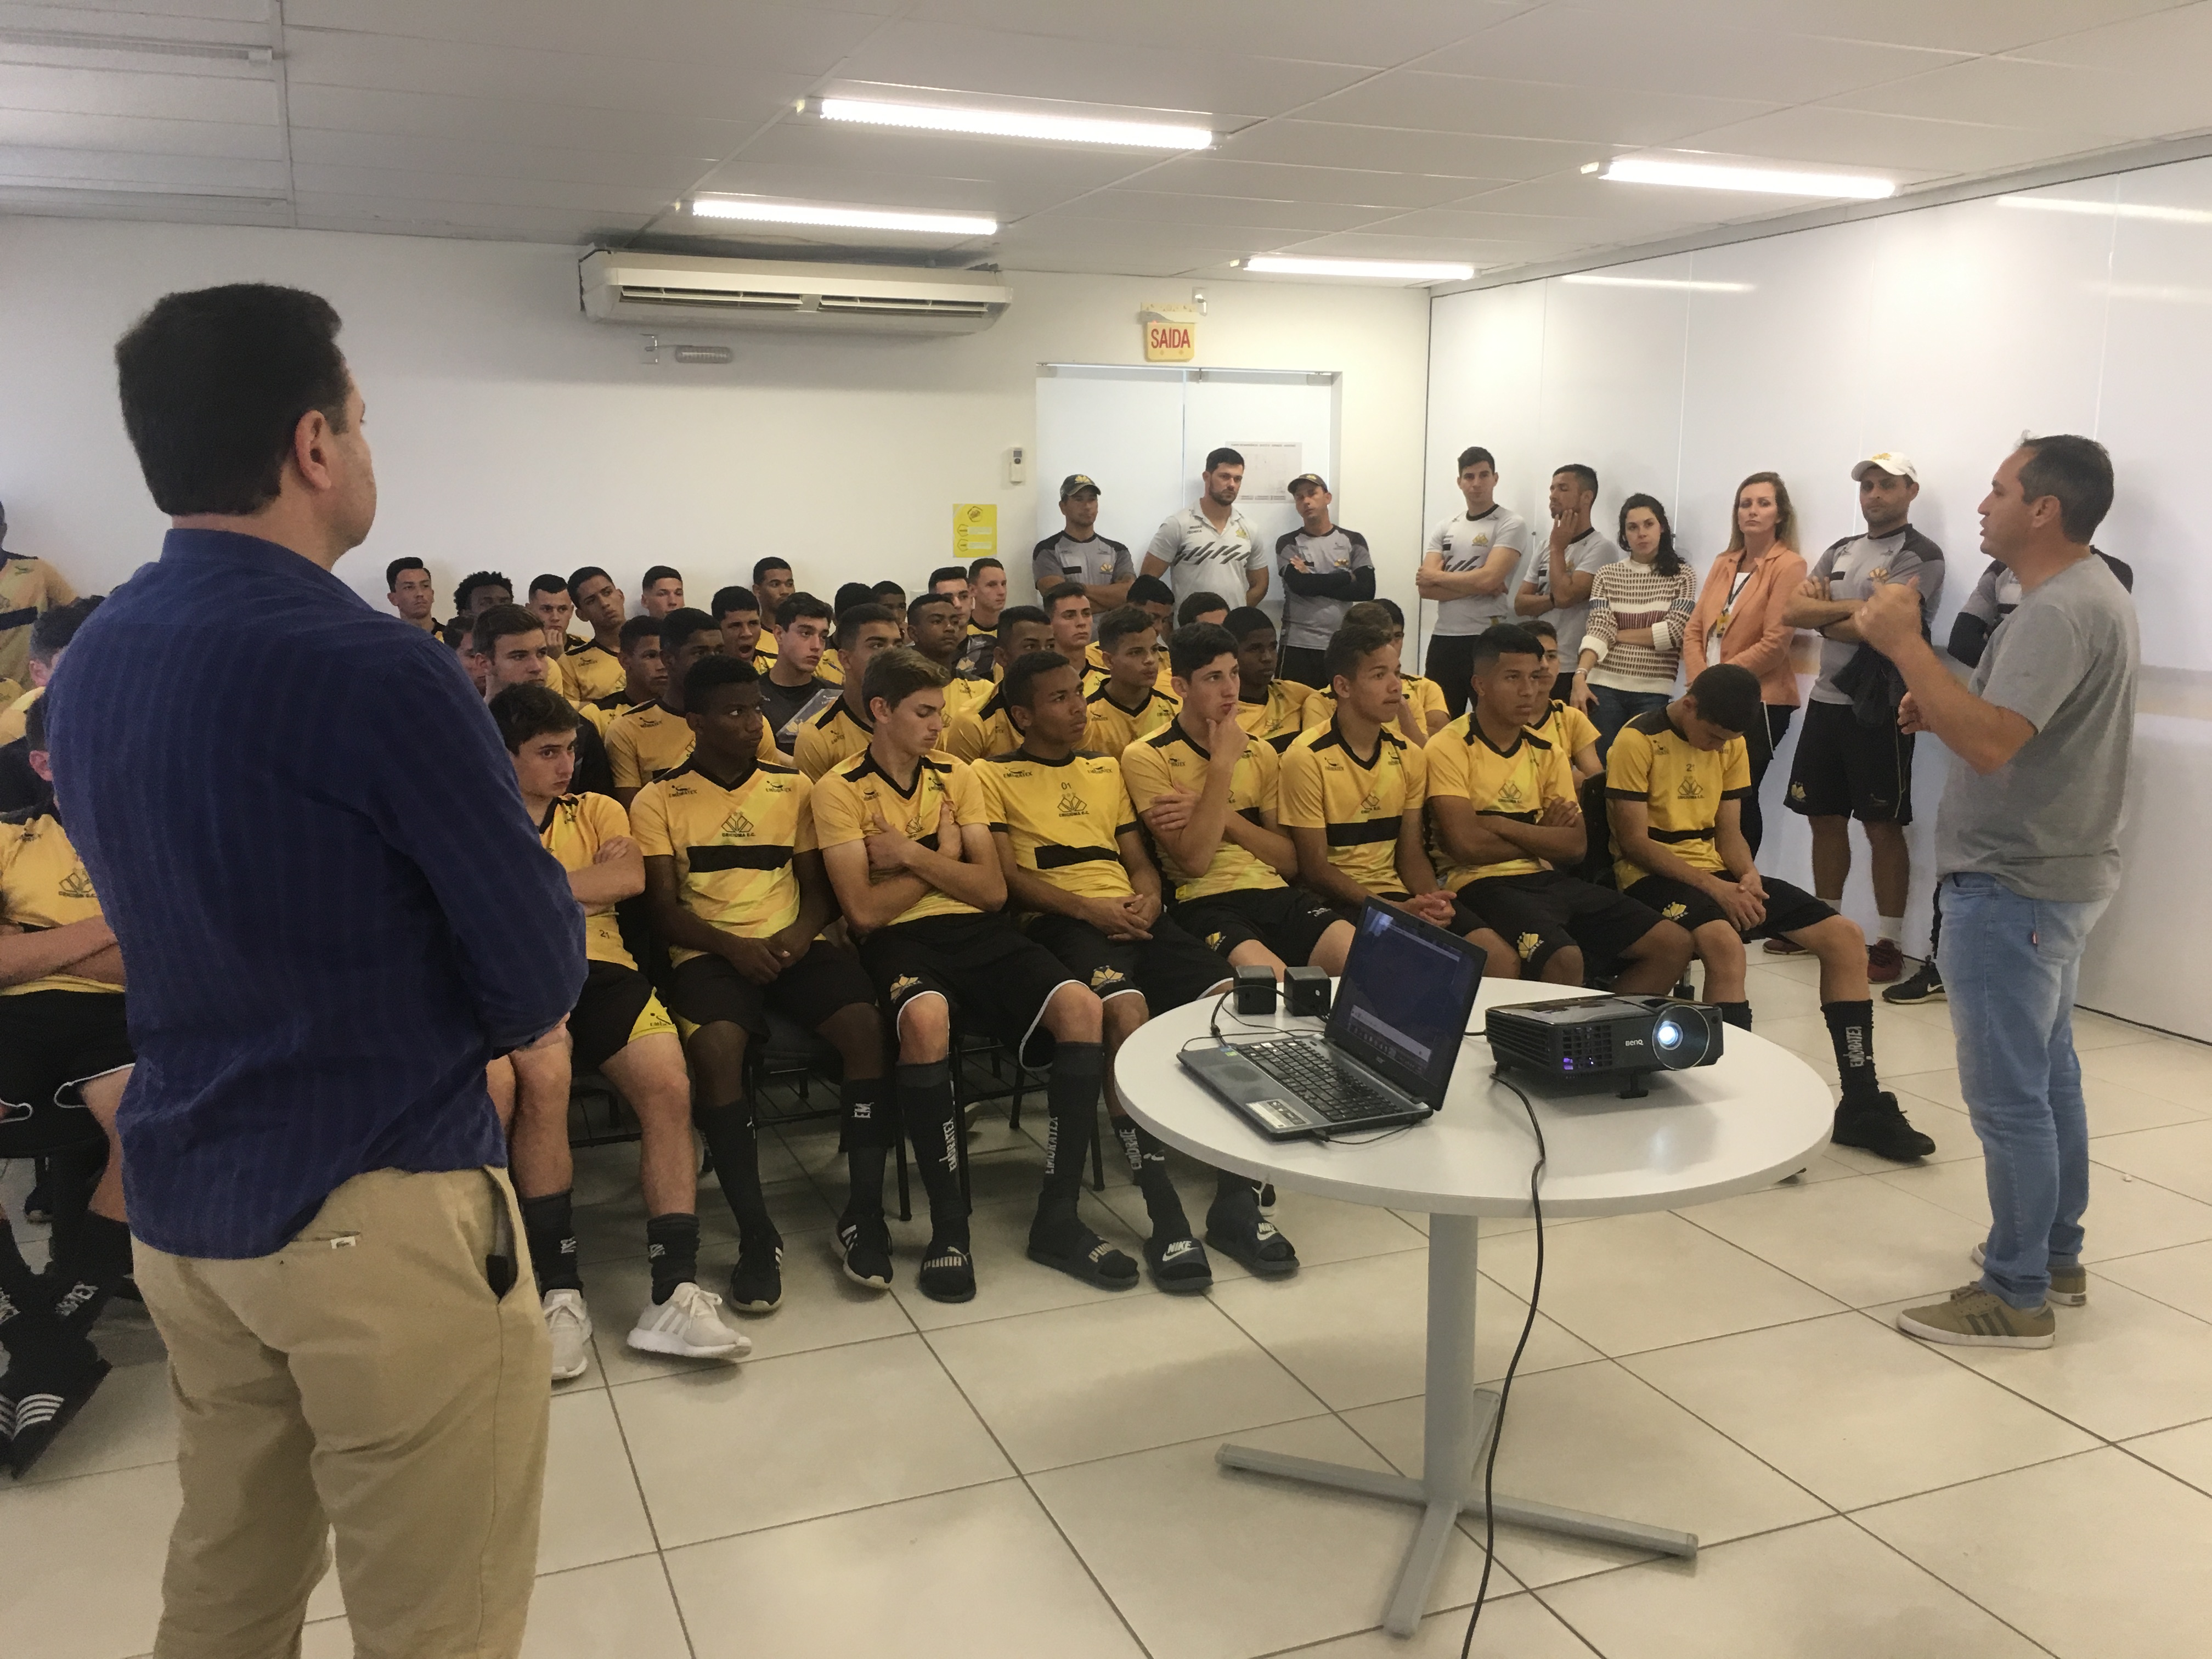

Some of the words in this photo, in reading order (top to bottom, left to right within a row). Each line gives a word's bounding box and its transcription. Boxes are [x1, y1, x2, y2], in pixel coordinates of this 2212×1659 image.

[1150, 328, 1191, 349] SAÍDA
[1060, 781, 1073, 790] 01
[599, 929, 610, 940] 21
[1624, 1039, 1644, 1047] BenQ
[1168, 1240, 1193, 1251] NIKE
[924, 1256, 962, 1271] PUMA
